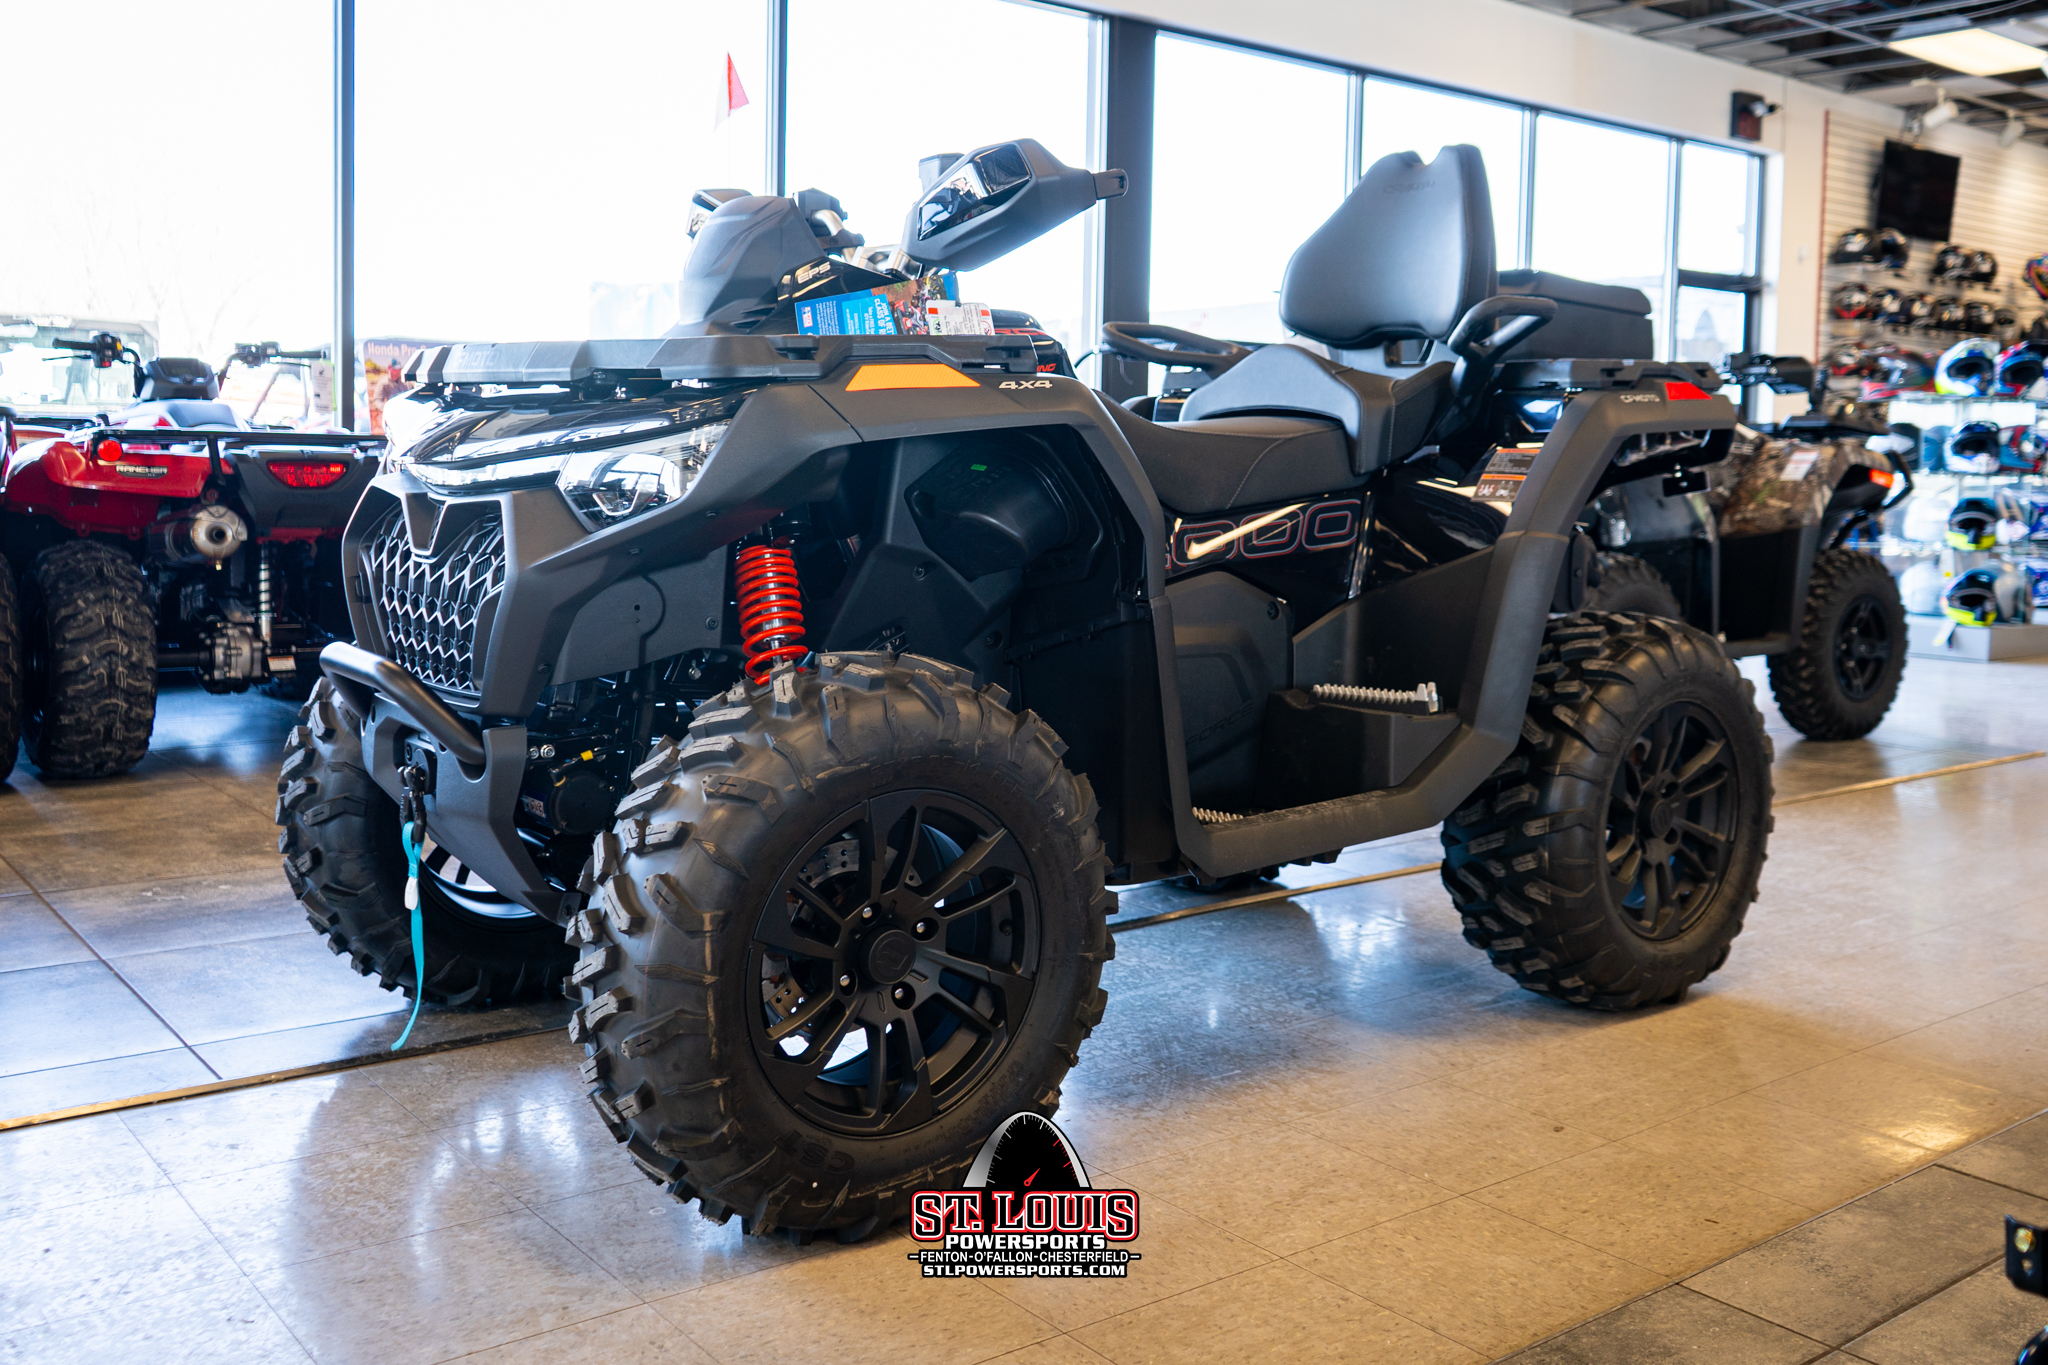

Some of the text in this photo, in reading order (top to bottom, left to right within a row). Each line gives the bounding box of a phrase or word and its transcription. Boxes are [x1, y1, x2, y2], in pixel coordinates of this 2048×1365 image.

[798, 261, 830, 284] EPS
[874, 298, 884, 319] CLASS
[881, 302, 889, 315] JOIN
[878, 319, 885, 327] OF
[368, 342, 400, 356] Honda
